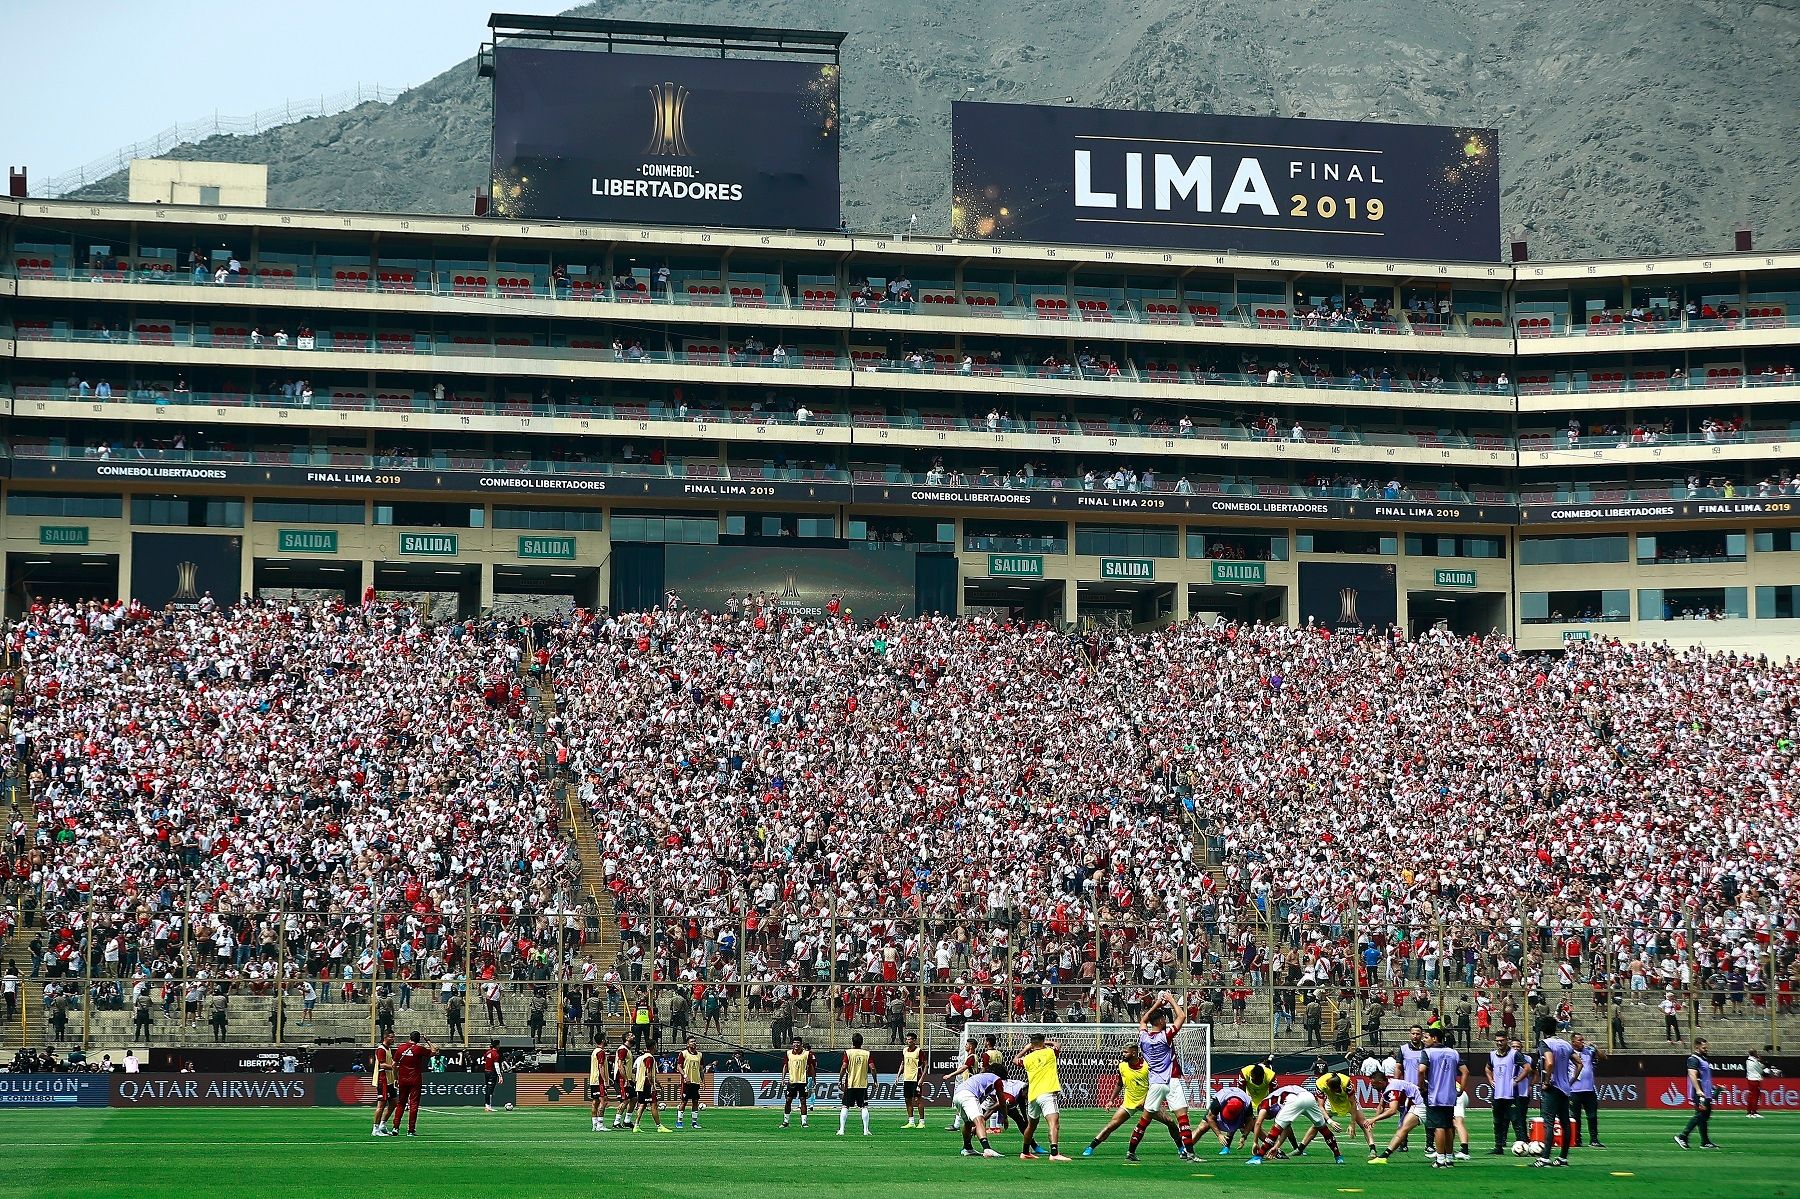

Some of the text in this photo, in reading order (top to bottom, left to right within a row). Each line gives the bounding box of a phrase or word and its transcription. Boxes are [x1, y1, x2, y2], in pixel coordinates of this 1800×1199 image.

[1291, 162, 1383, 183] FINAL
[592, 176, 742, 200] LIBERTADORES
[1075, 150, 1279, 215] LIMA
[1291, 195, 1383, 220] 2019
[97, 467, 226, 478] CONMEBOL LIBERTADORES
[308, 473, 341, 481] FINAL
[480, 477, 605, 490] CONMEBOL LIBERTADORES
[685, 485, 774, 495] FINAL LIMA 2019
[911, 491, 1031, 504] CONMEBOL LIBERTADORES
[1212, 501, 1328, 514] CONMEBOL LIBERTADORES
[1551, 506, 1674, 519] CONMEBOL LIBERTADORES
[1735, 504, 1762, 512] LIMA
[45, 529, 84, 542] SALIDA
[285, 533, 332, 549] SALIDA
[405, 537, 452, 552] SALIDA
[524, 540, 571, 555] SALIDA
[994, 558, 1038, 574] SALIDA
[1106, 561, 1149, 577] SALIDA
[1217, 564, 1261, 579] SALIDA
[1438, 572, 1473, 585] SALIDA
[119, 1081, 304, 1102] QATAR AIRWAYS
